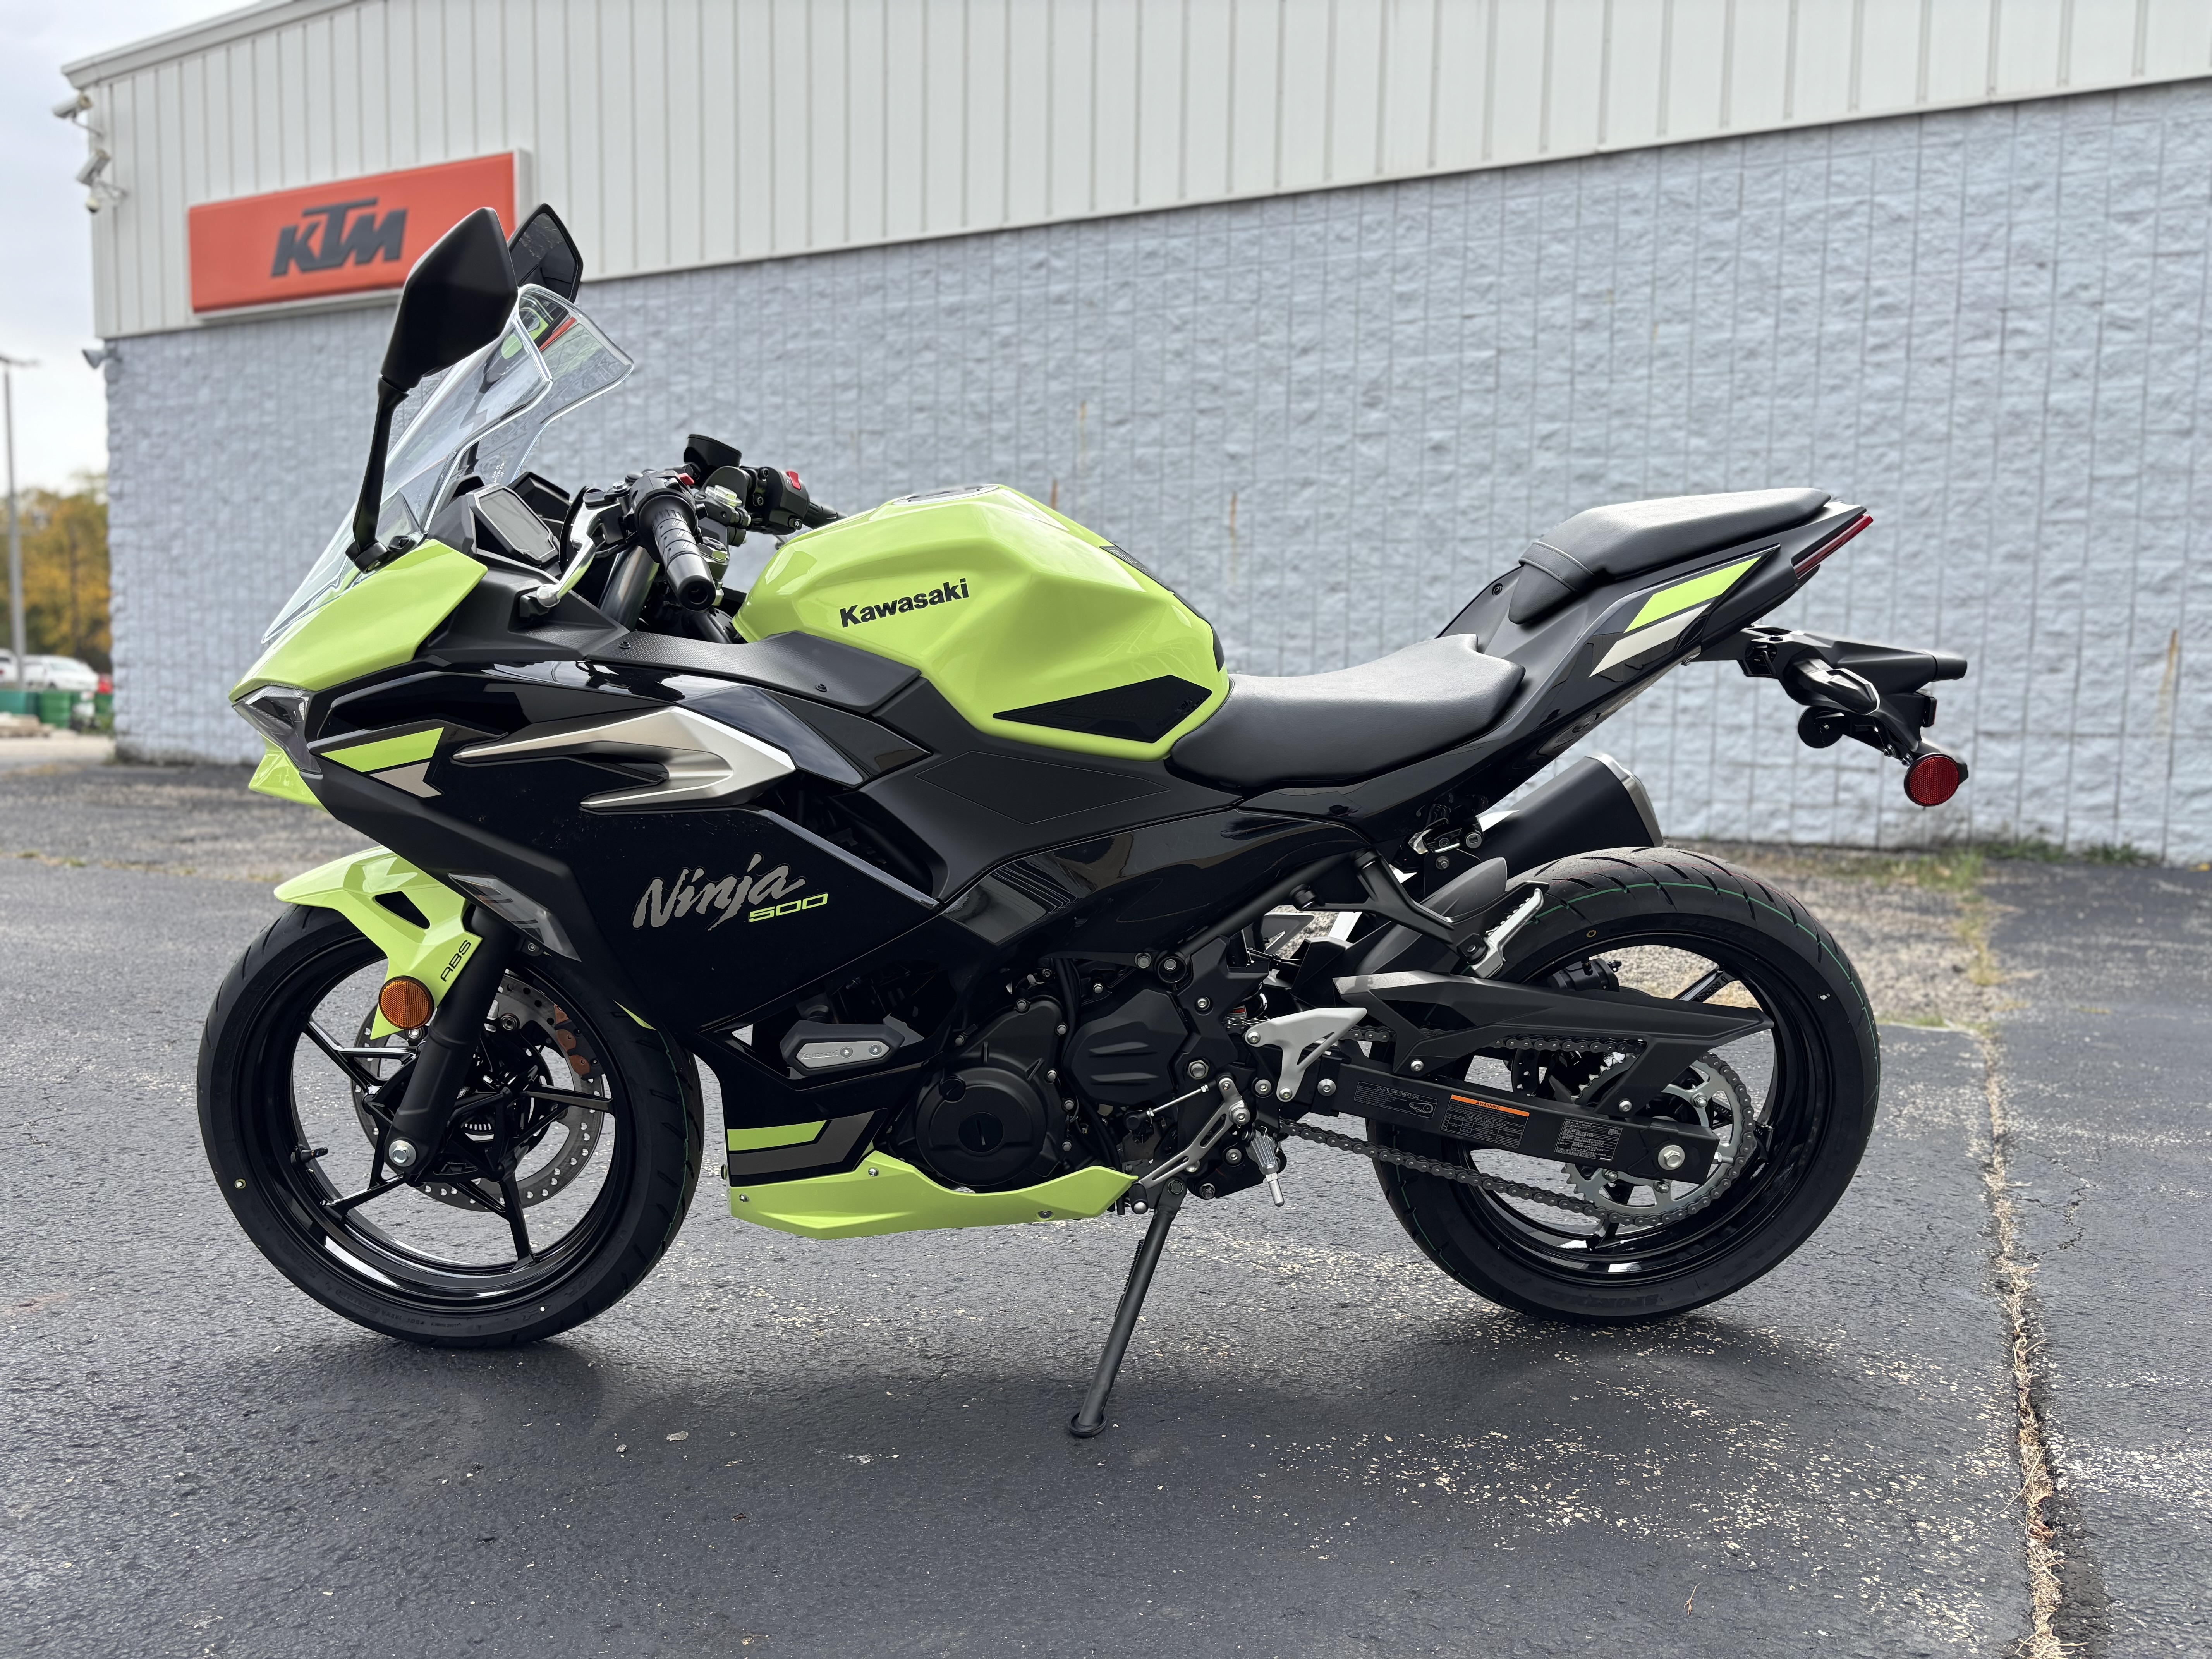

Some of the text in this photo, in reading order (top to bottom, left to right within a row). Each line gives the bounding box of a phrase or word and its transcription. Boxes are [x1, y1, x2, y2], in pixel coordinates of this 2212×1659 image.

[271, 197, 407, 277] KTM
[840, 578, 969, 628] Kawasaki
[632, 852, 806, 931] Ninja
[749, 893, 828, 922] 500
[440, 939, 471, 982] ABS
[1390, 1090, 1420, 1099] INFORMATION
